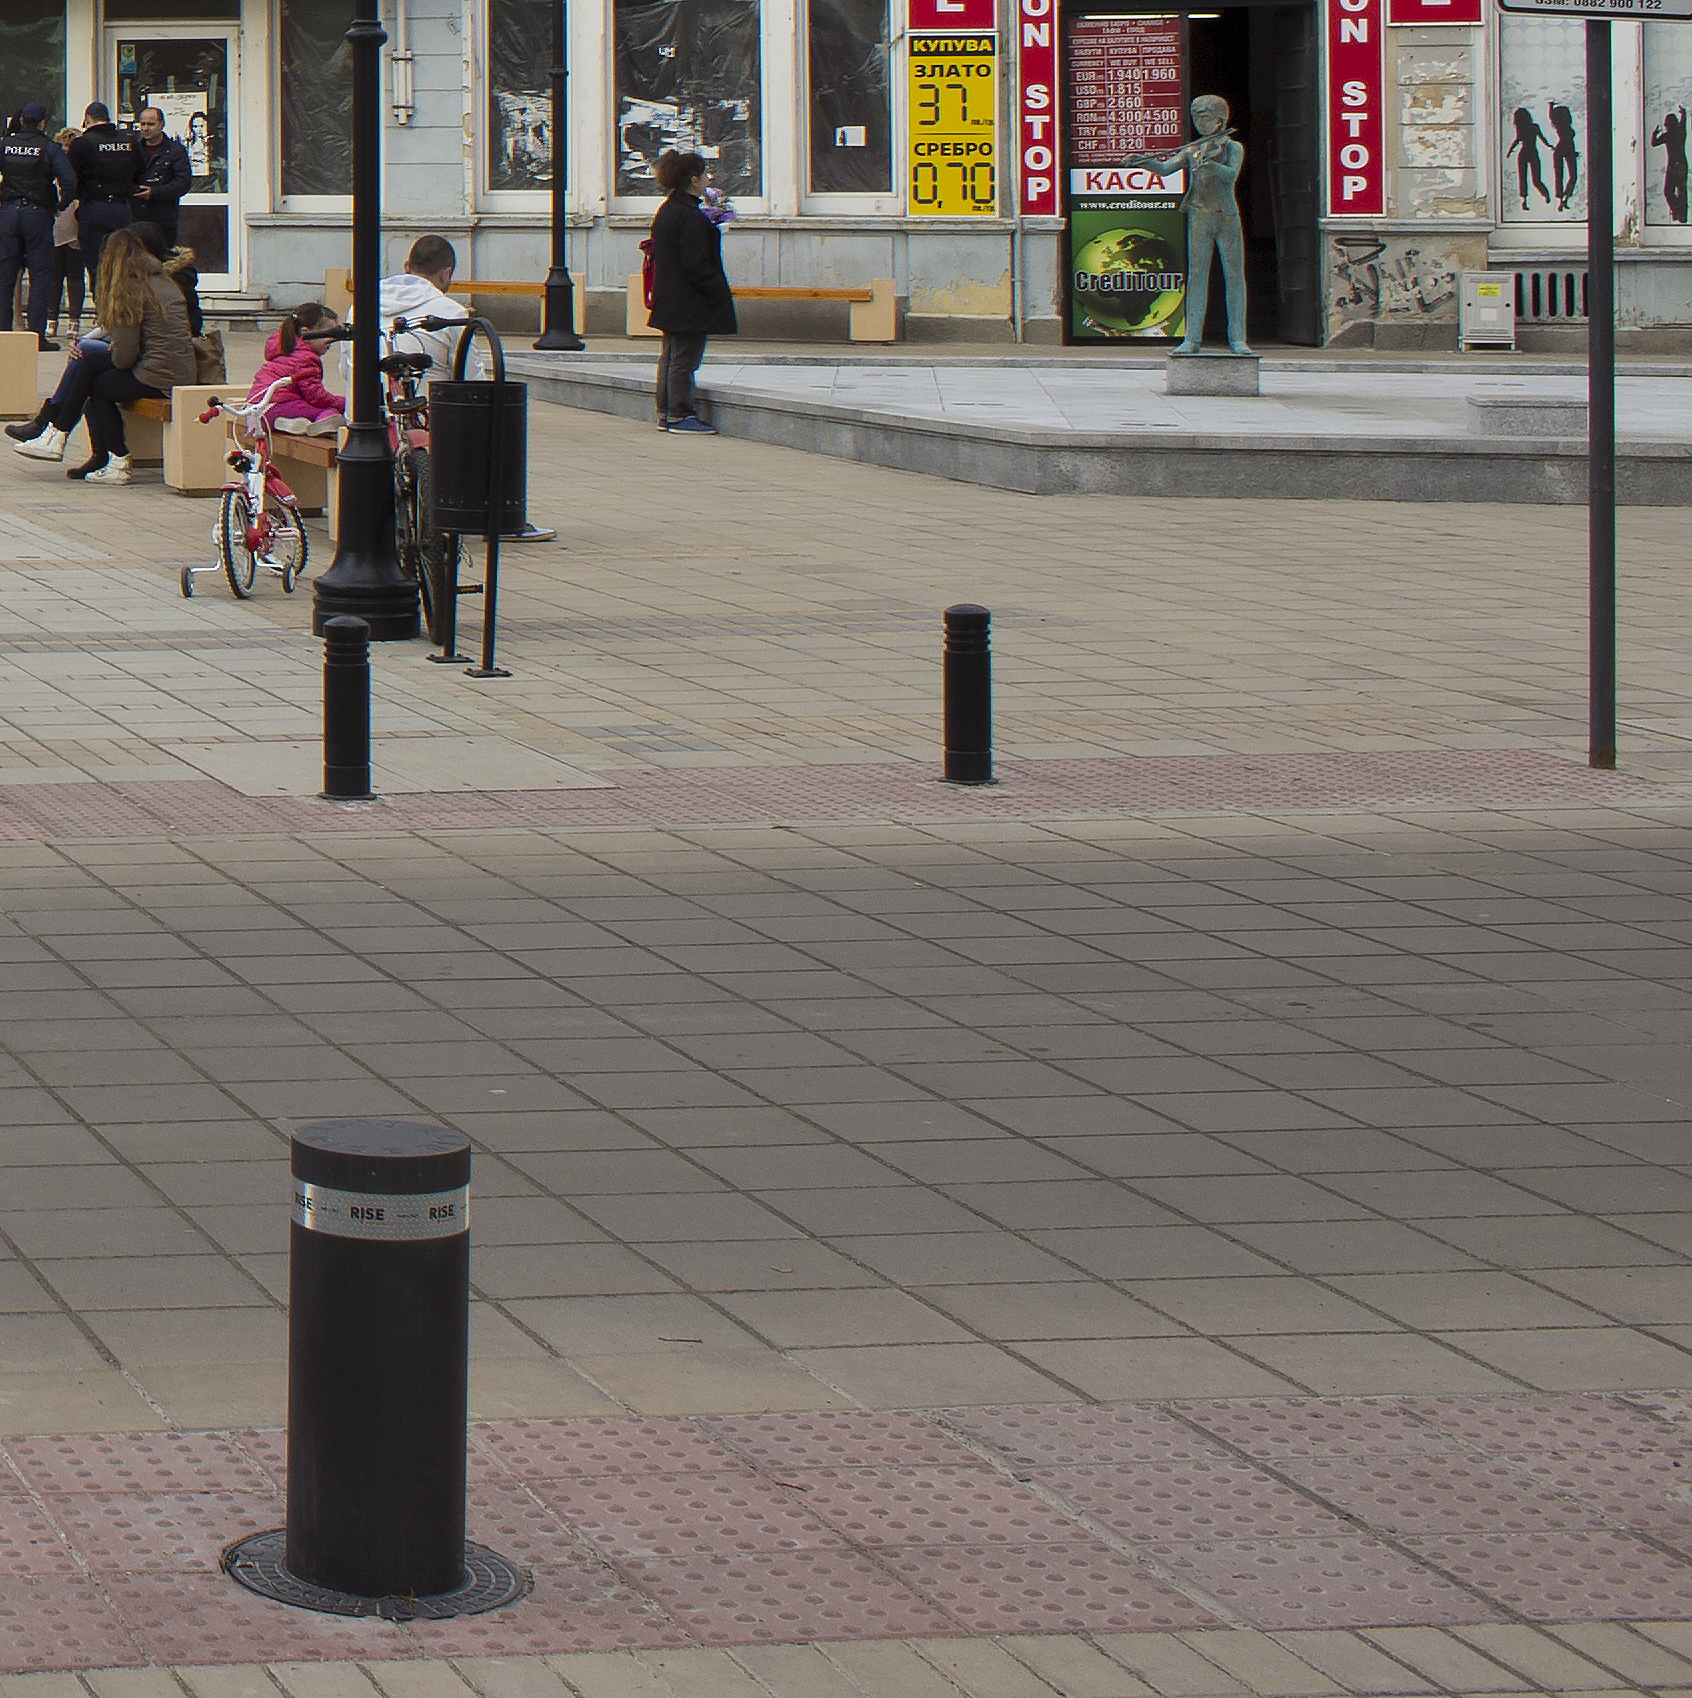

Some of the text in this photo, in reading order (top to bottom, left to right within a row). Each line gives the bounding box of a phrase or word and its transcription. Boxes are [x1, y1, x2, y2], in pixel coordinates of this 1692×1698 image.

[1638, 0, 1662, 9] 122
[914, 39, 992, 52] КУПУВА
[914, 64, 991, 78] ЗЛАТО
[1076, 71, 1096, 81] EUR
[918, 83, 967, 126] 37
[98, 143, 131, 152] POLICE
[1024, 84, 1052, 201] STOP
[1340, 81, 1369, 201] STOP
[4, 145, 41, 157] POLICE
[914, 142, 993, 157] СРЕБРО
[913, 162, 995, 209] 0,70
[1085, 171, 1165, 191] КАСА
[1075, 269, 1184, 292] CrediTour
[350, 1205, 386, 1221] RISE
[428, 1203, 456, 1220] RISE
